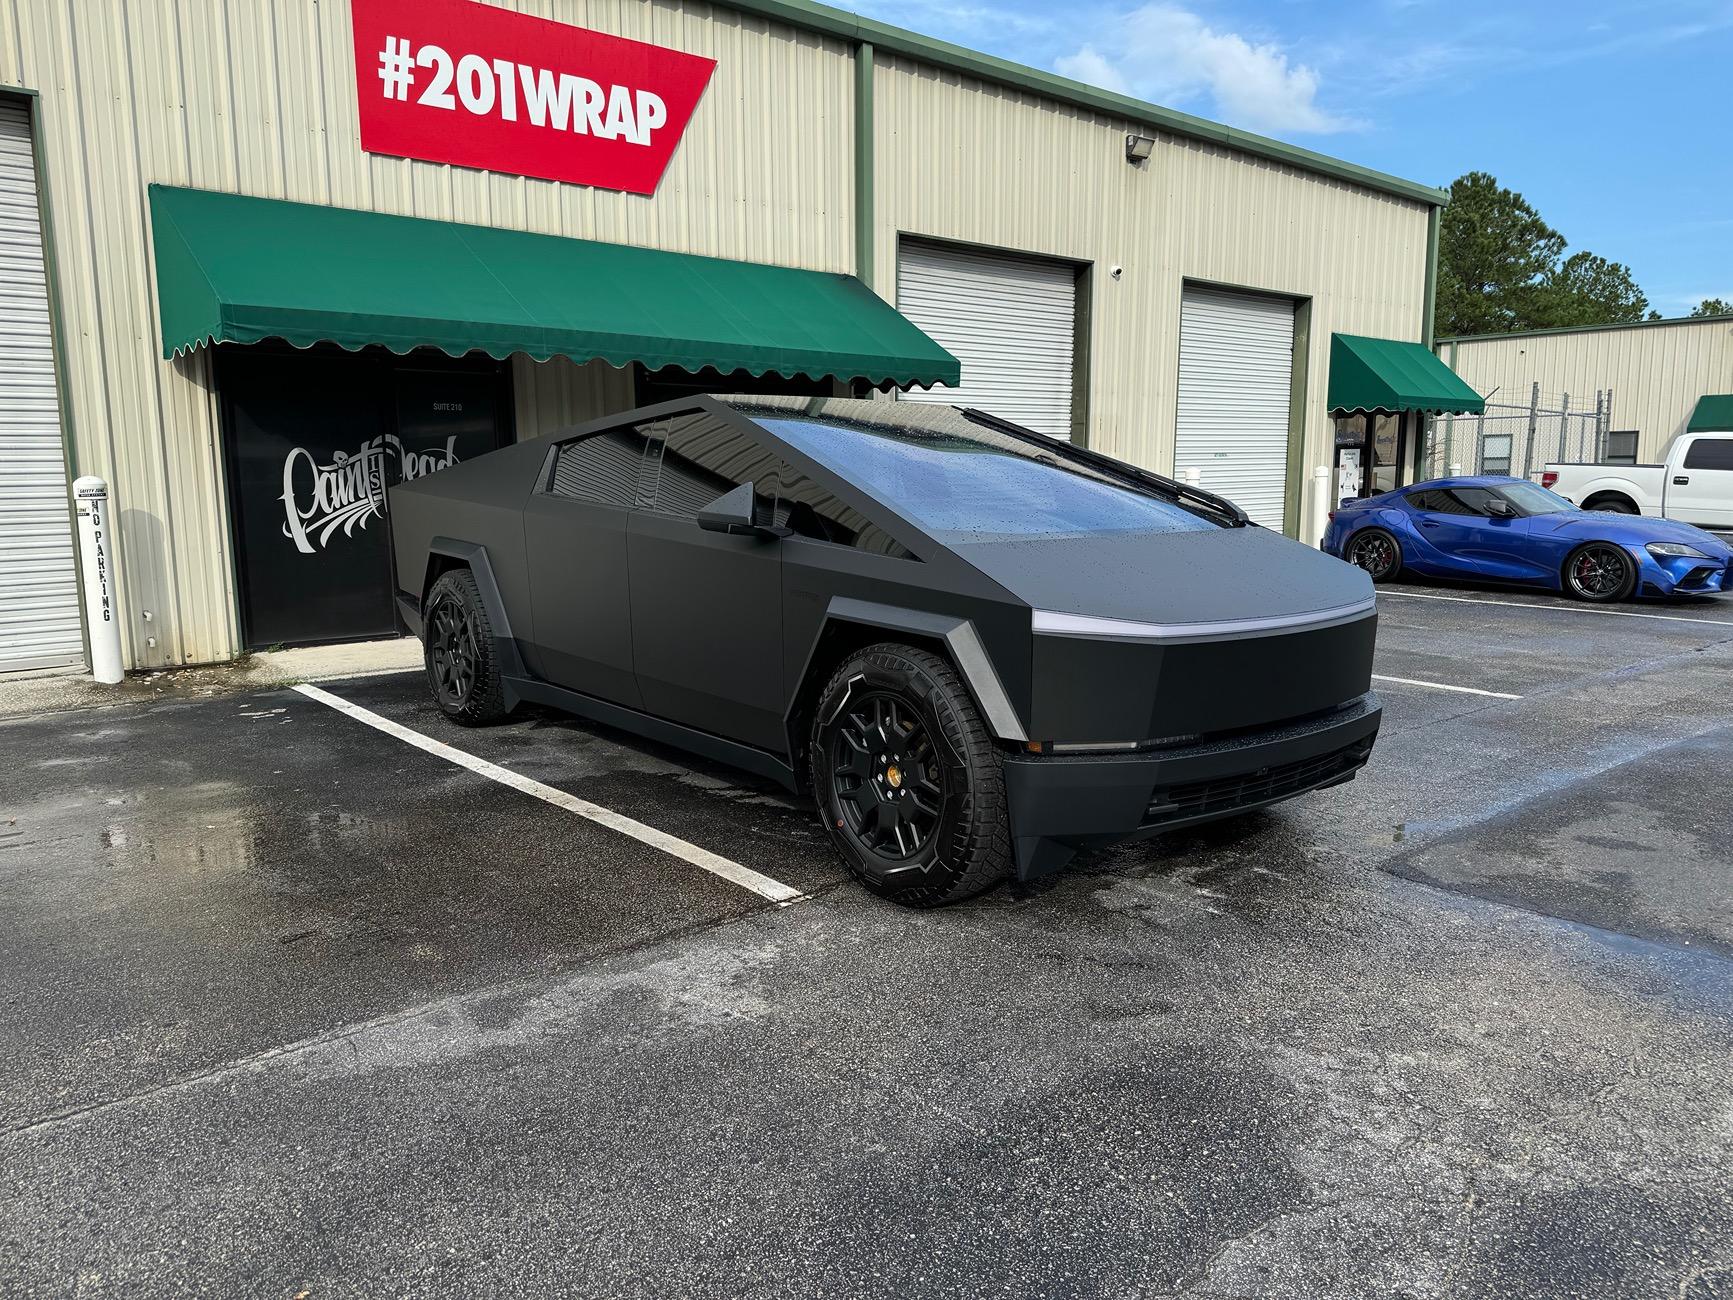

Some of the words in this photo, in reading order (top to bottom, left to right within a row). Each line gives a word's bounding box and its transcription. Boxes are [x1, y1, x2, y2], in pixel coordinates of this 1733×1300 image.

[378, 35, 667, 146] #201WRAP
[433, 403, 449, 411] SUITE
[451, 403, 463, 411] 210
[278, 441, 385, 553] Paint
[94, 530, 110, 622] PARKING
